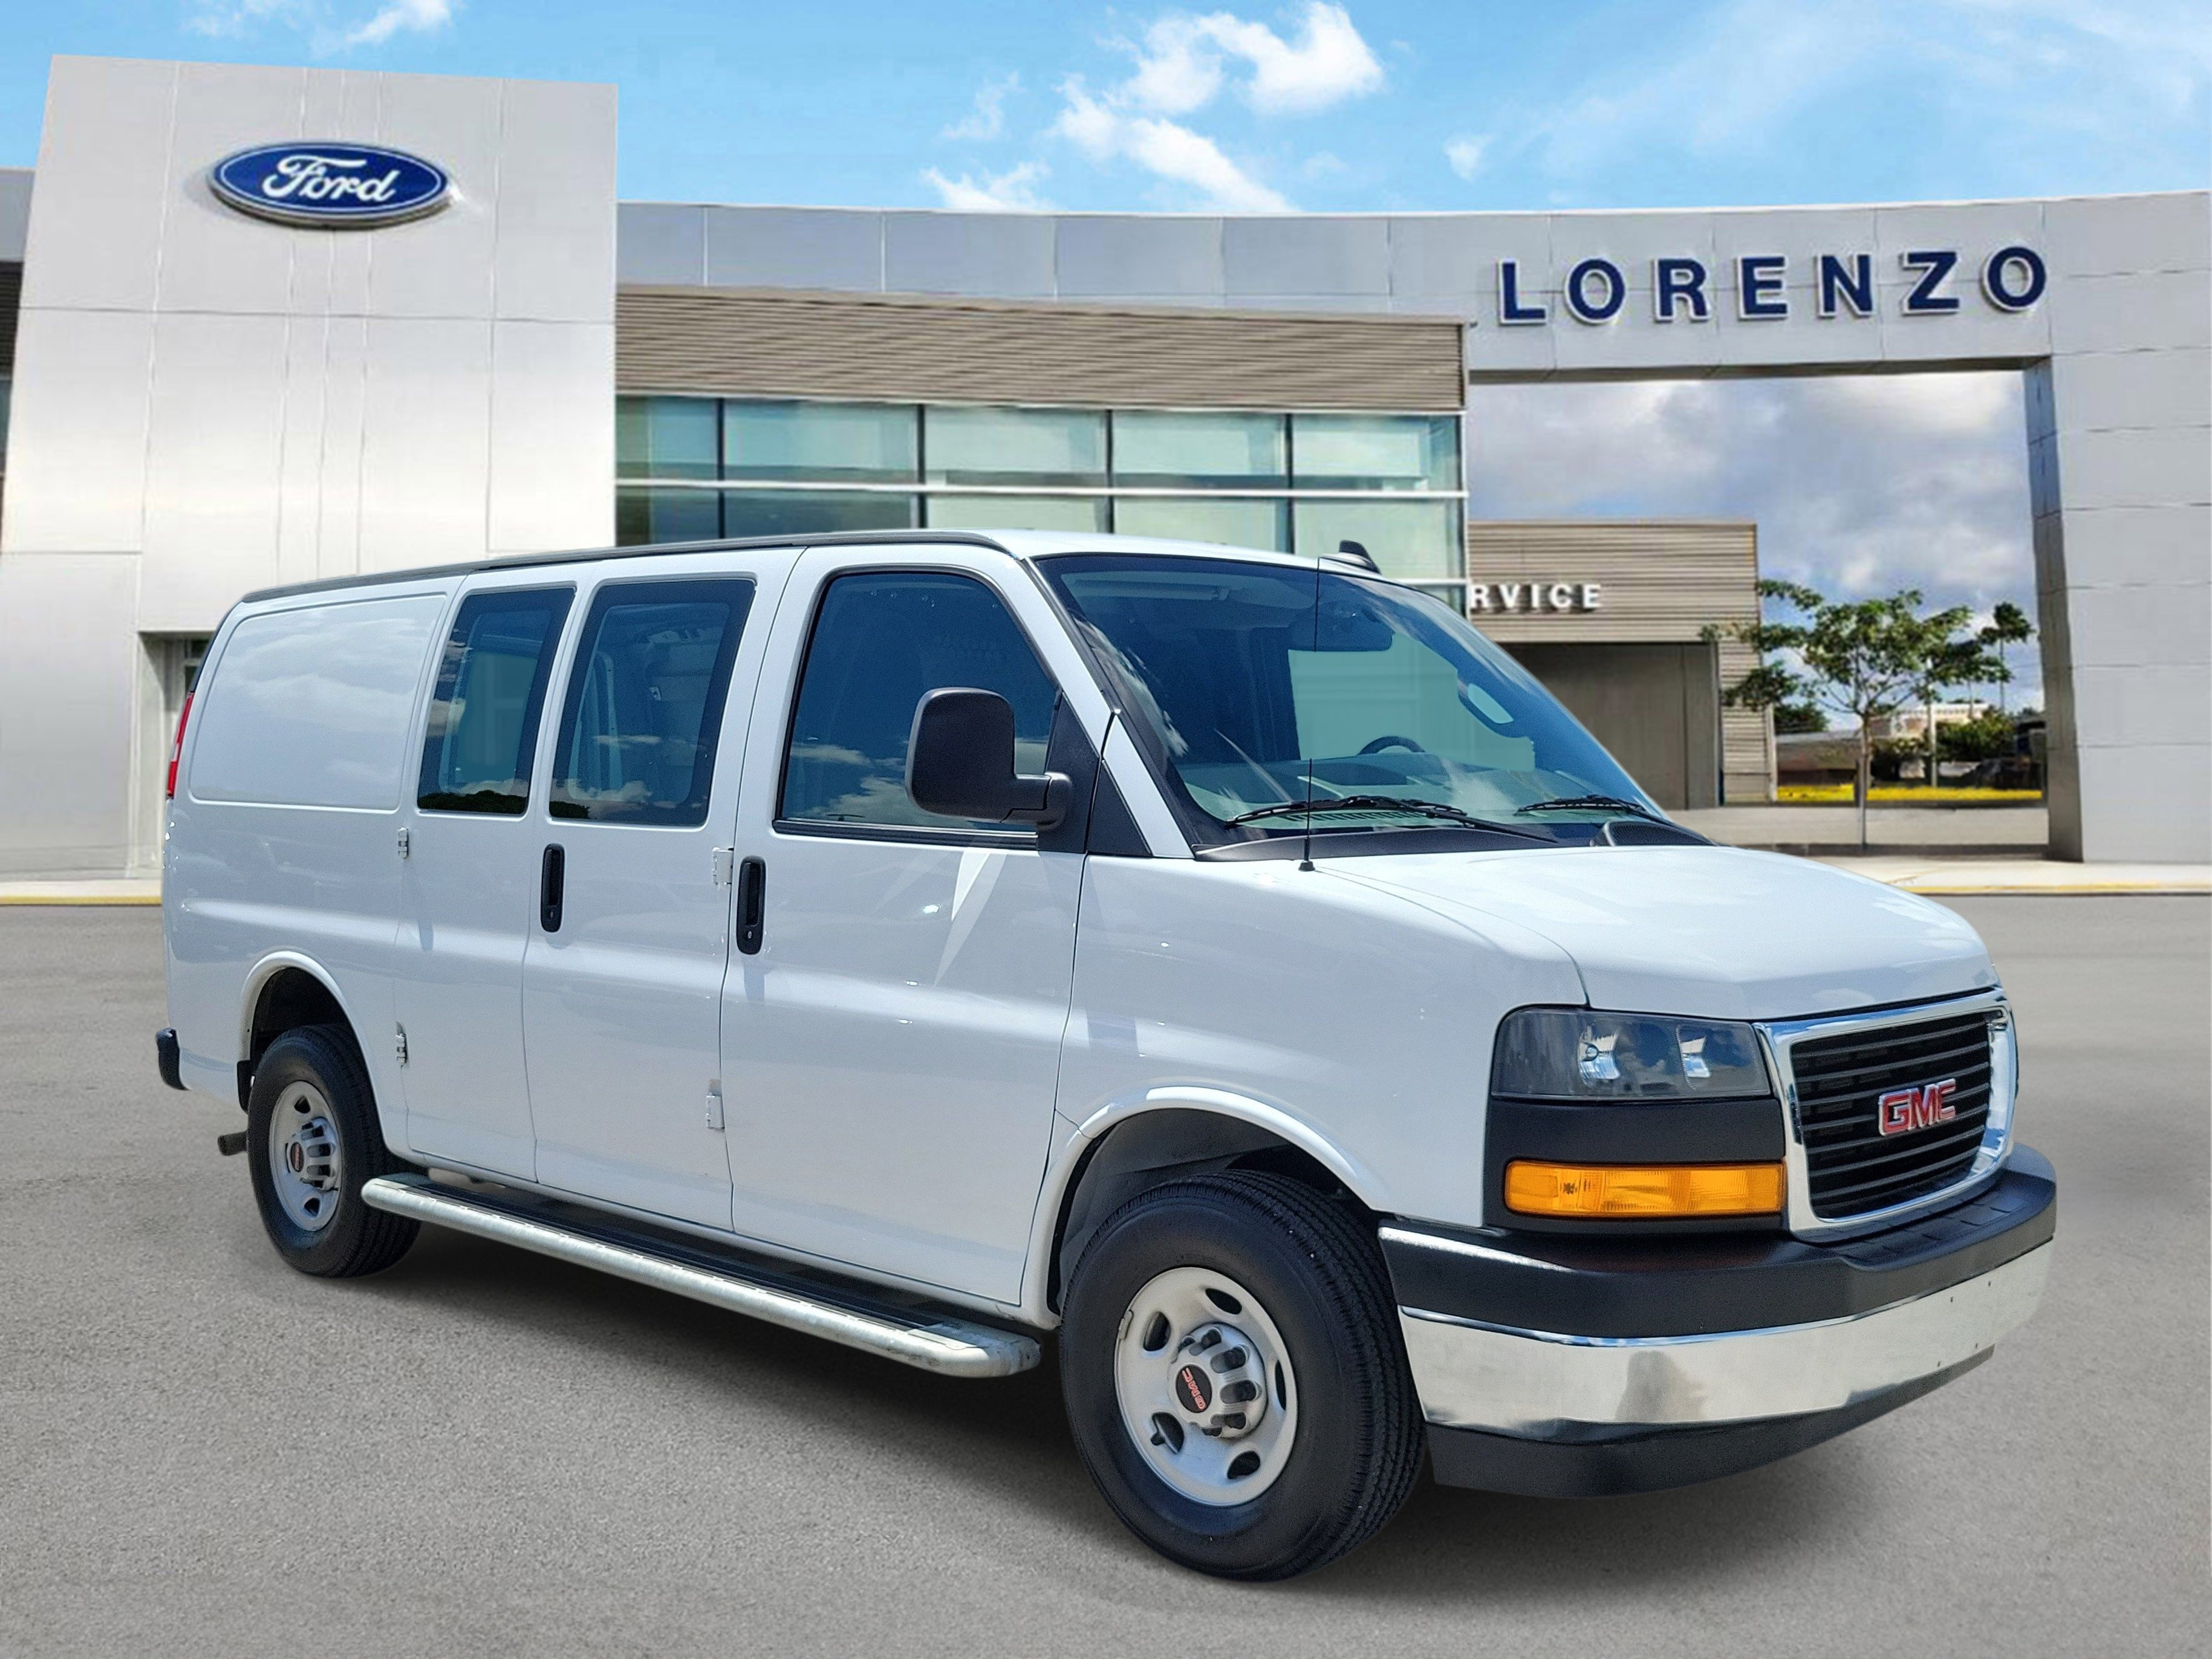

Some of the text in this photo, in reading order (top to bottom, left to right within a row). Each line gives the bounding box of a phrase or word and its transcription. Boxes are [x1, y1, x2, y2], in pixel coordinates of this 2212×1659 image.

[262, 155, 400, 202] Ford
[1497, 246, 2047, 324] LORENZO
[1470, 583, 1602, 608] RVICE
[1878, 1078, 1956, 1137] GMC
[1182, 1367, 1206, 1410] GMC
